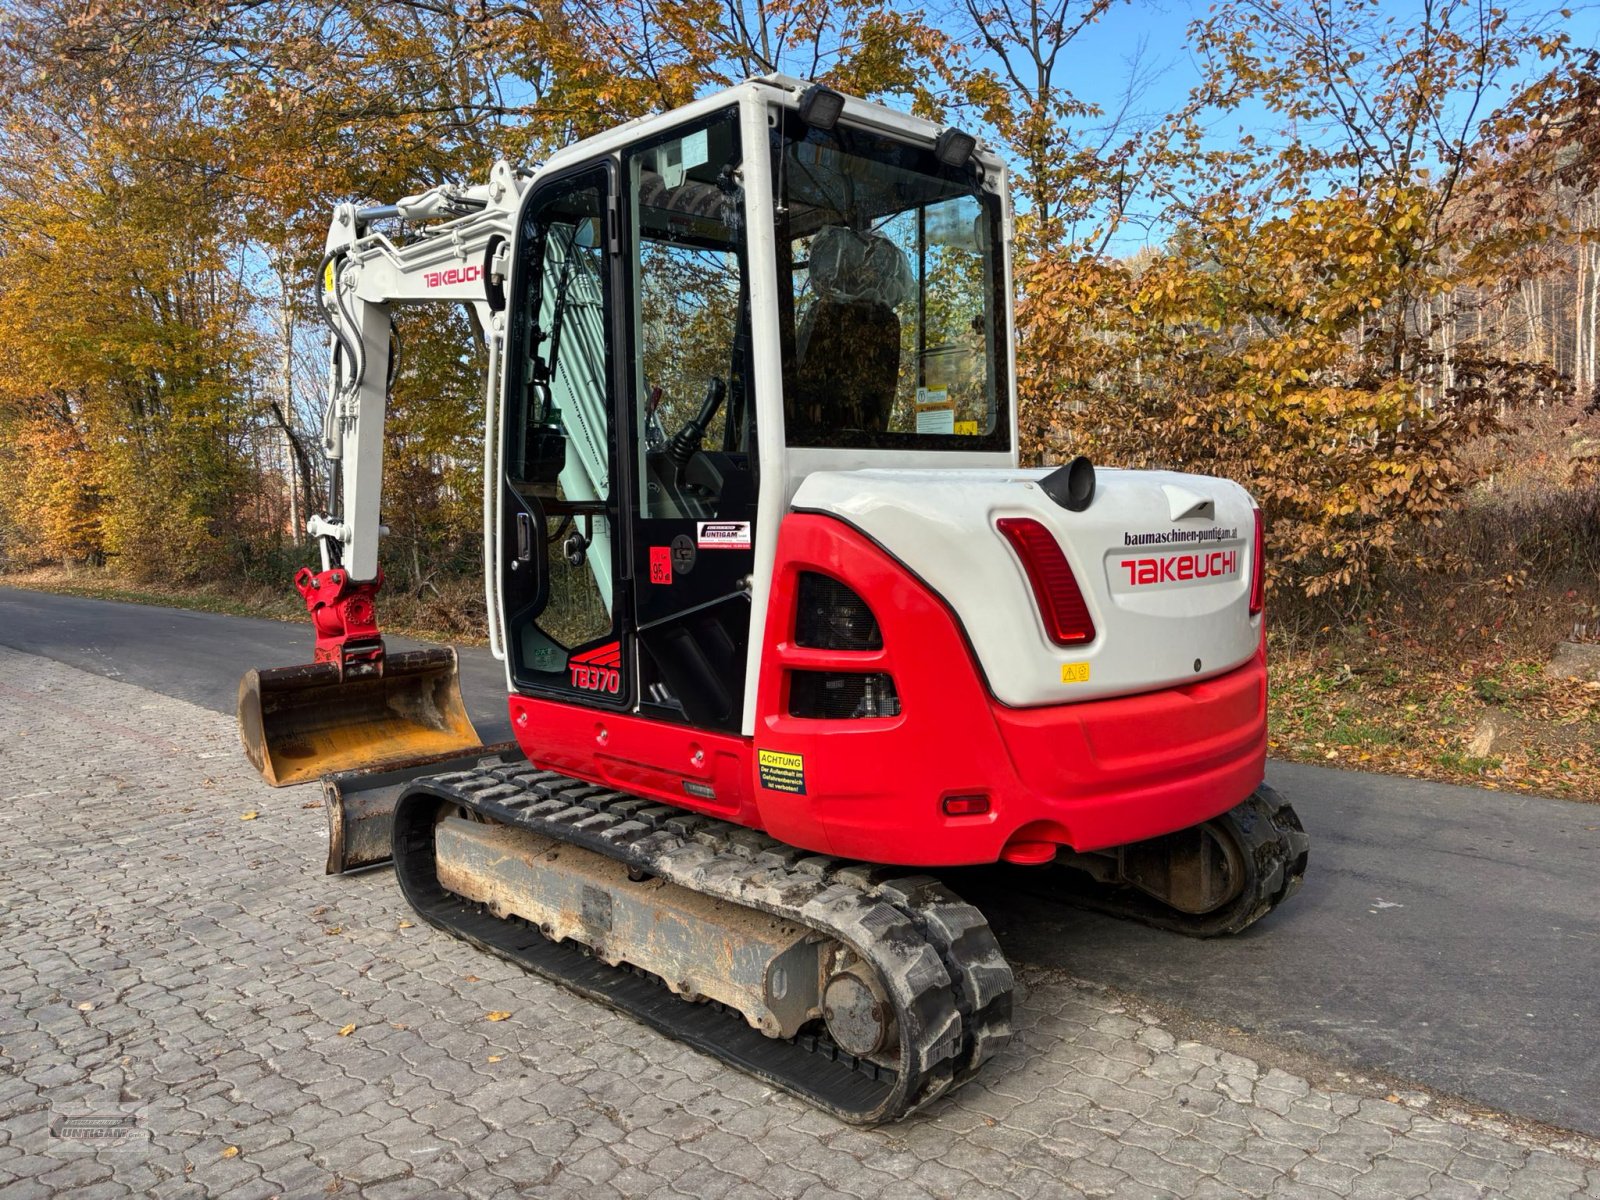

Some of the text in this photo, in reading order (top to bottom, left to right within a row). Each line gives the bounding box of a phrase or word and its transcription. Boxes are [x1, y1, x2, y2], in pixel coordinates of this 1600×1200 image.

[424, 265, 485, 288] TAKEUCH
[1124, 526, 1237, 546] baumaschinen-puntigam.at
[653, 563, 664, 580] 95
[1121, 550, 1236, 586] TAKEUCHI
[569, 663, 620, 694] TB370
[761, 754, 801, 767] ACHTUNG
